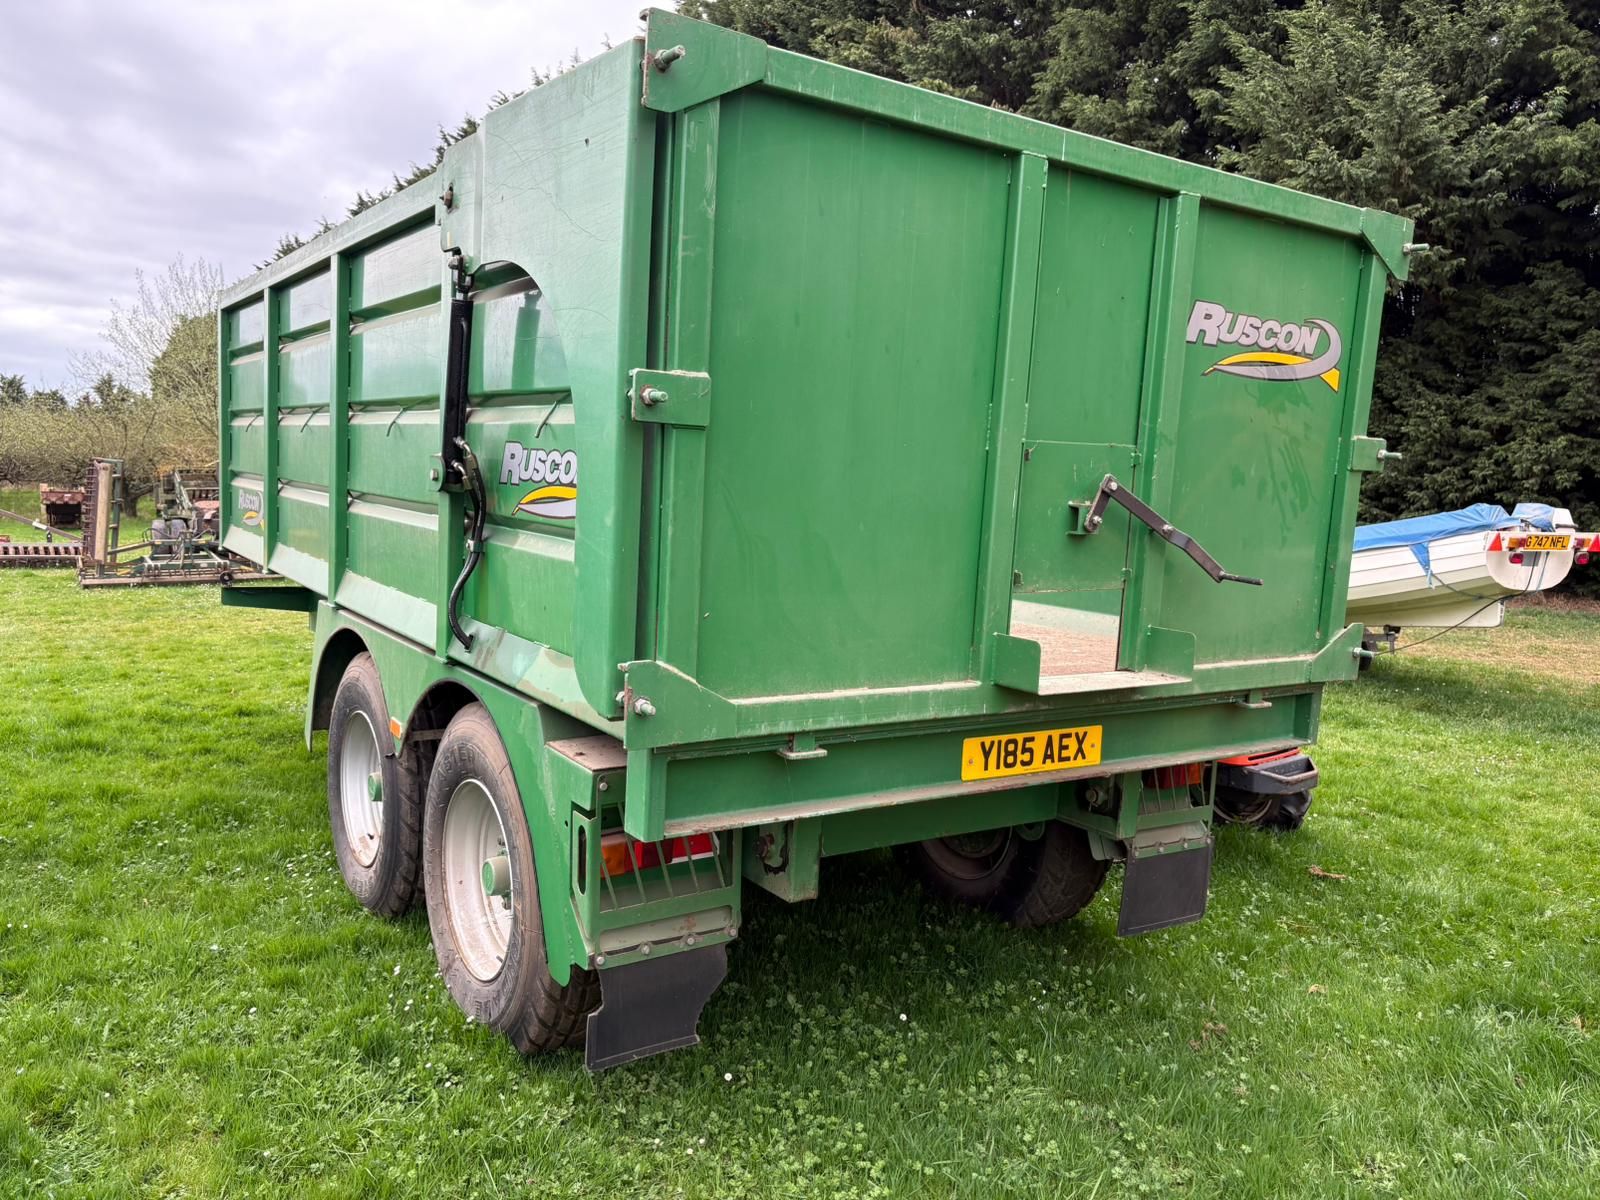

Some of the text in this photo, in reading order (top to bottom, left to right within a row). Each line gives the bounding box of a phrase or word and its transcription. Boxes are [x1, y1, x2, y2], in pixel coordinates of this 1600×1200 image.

[1186, 300, 1320, 355] RUSCON
[499, 441, 577, 486] RUSCO
[1549, 536, 1566, 548] NFL
[980, 731, 1088, 771] Y185 AEX
